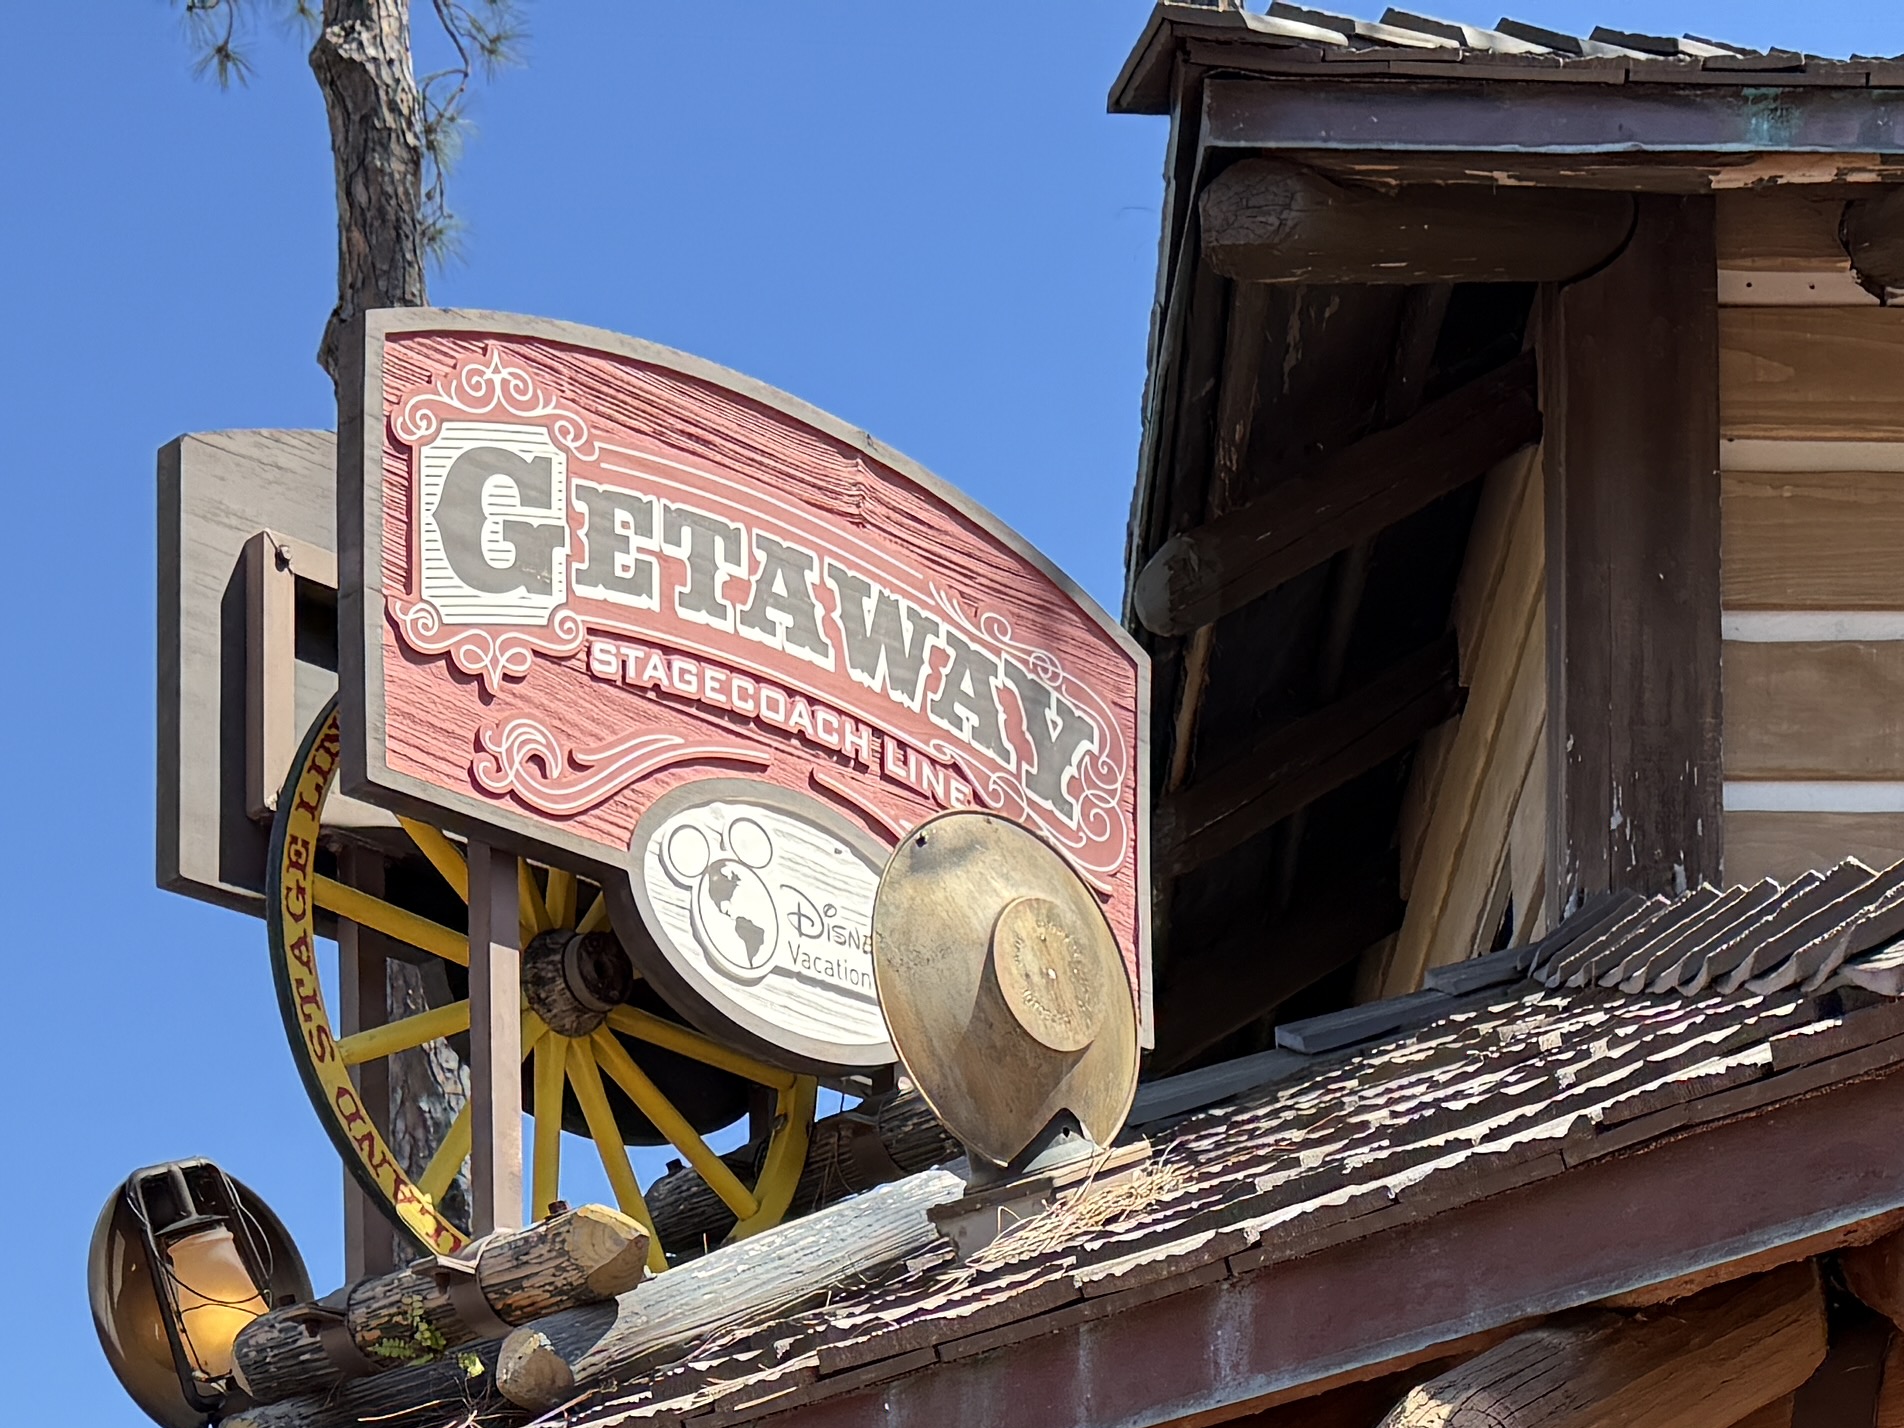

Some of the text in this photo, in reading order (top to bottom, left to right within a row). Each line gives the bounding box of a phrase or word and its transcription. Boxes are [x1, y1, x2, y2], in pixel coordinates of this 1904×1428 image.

[432, 446, 1099, 832] GETAWAY
[295, 708, 340, 822] LIN
[590, 641, 973, 808] STAGECOACH LINE
[285, 834, 335, 1064] STAGE
[787, 939, 872, 990] Vacation
